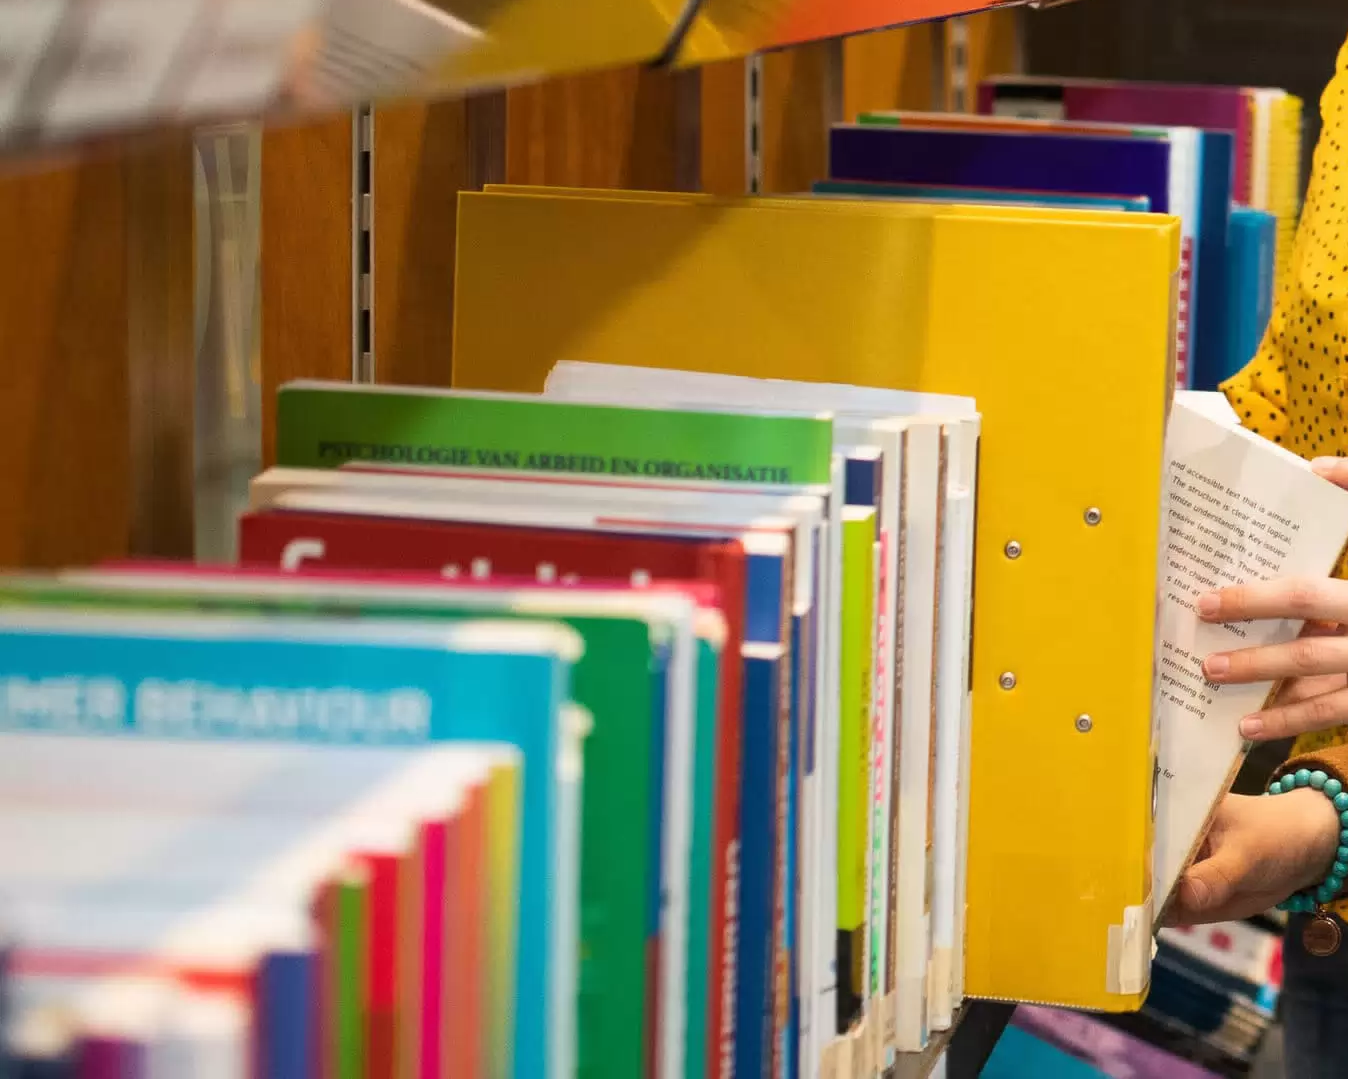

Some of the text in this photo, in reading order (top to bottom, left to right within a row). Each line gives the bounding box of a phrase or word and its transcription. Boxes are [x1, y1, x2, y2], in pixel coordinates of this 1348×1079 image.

[319, 441, 793, 484] PSYCHOLOGIE VAN ARBEID EN ORGANISATIE
[1173, 476, 1187, 489] The
[1188, 485, 1222, 507] structure
[1231, 508, 1251, 522] clear
[1251, 519, 1266, 531] and
[1187, 469, 1224, 491] accessible
[1225, 488, 1241, 500] text
[1242, 497, 1258, 509] that
[1267, 511, 1291, 527] aimed
[1197, 522, 1229, 546] learning
[1230, 541, 1247, 554] with
[1255, 553, 1281, 573] logical
[1248, 533, 1263, 546] Key
[1263, 542, 1288, 559] issues
[1168, 542, 1221, 575] understanding
[1220, 570, 1237, 583] and
[1169, 560, 1188, 574] each
[1199, 542, 1214, 554] into
[1238, 560, 1260, 577] There
[1173, 578, 1191, 592] that
[1167, 592, 1199, 614] resourc
[1223, 622, 1247, 639] which
[1174, 647, 1191, 658] and
[1203, 679, 1221, 692] and
[0, 675, 127, 732] MER
[1169, 695, 1185, 706] and
[1185, 703, 1206, 719] using
[1163, 769, 1176, 780] for
